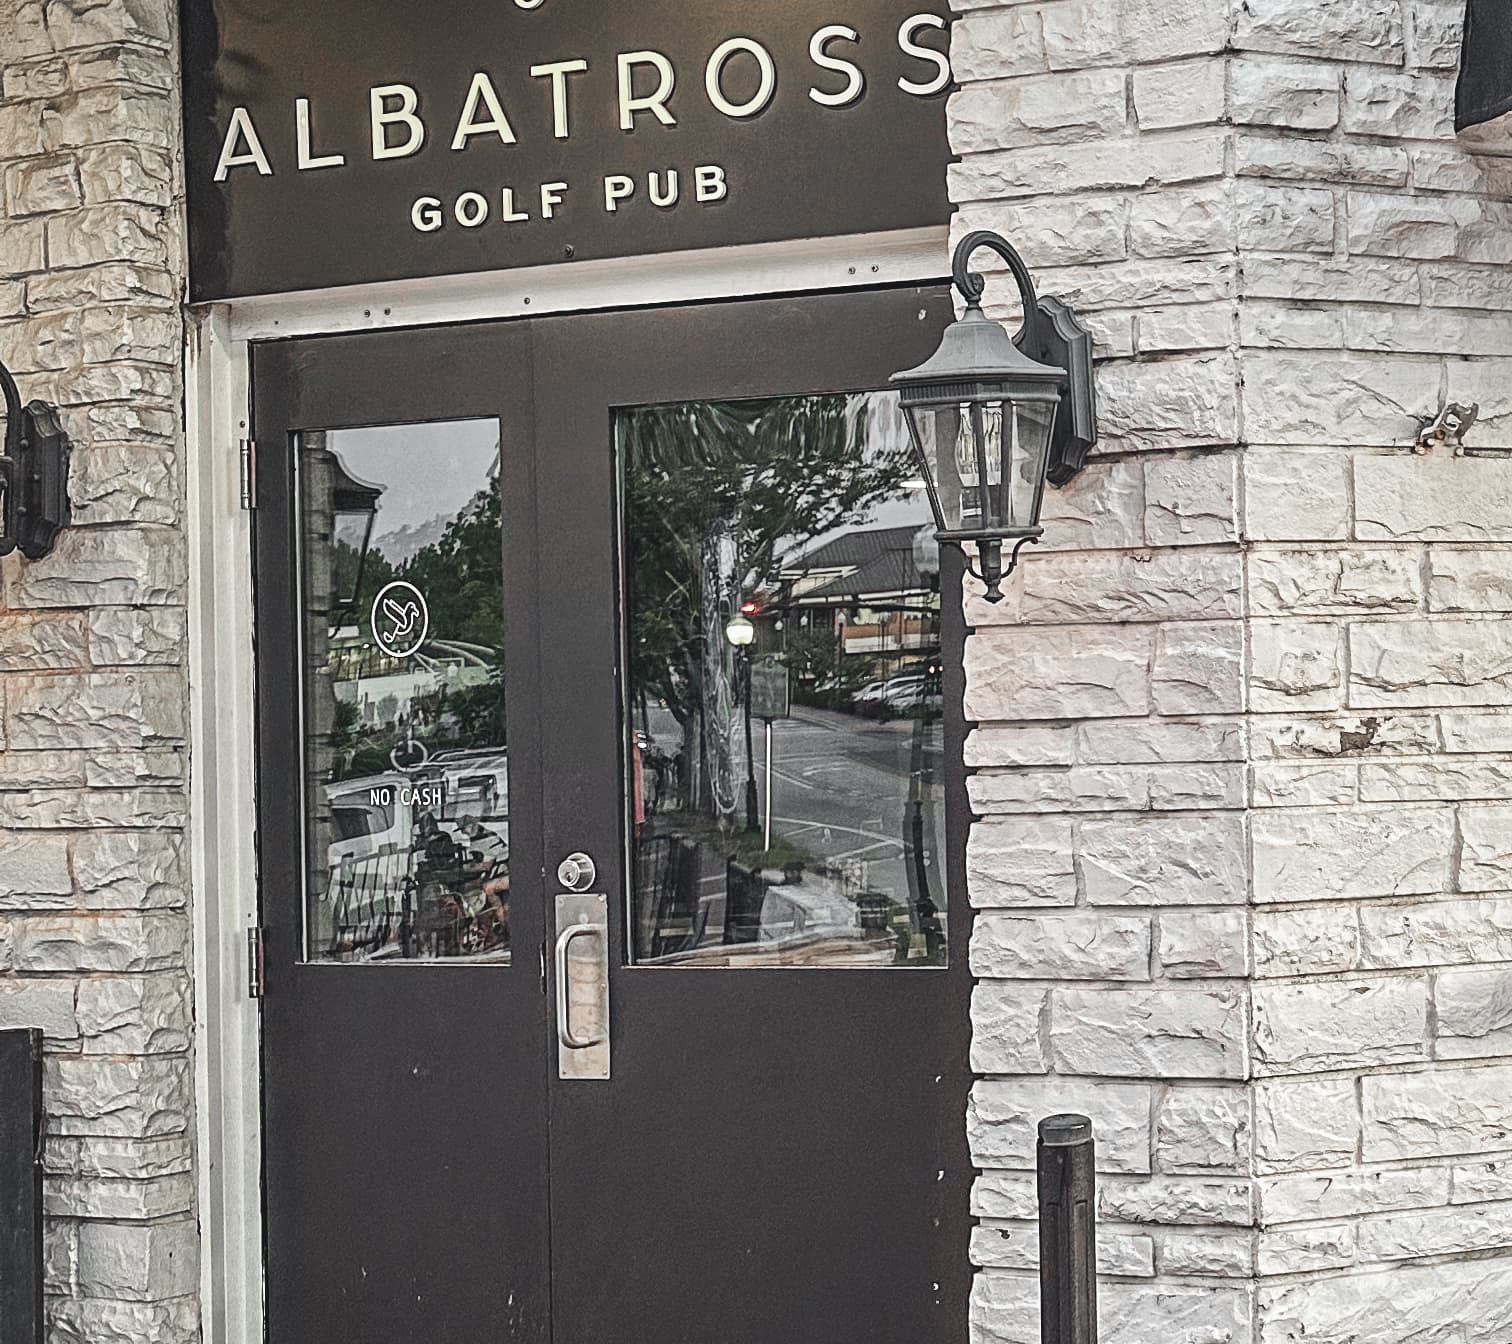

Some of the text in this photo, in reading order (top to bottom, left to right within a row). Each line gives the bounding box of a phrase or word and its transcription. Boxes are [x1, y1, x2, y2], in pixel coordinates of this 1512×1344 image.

[213, 12, 953, 183] ALBATROSS
[411, 165, 729, 233] GOLF PUB
[370, 787, 442, 806] NO CASH
